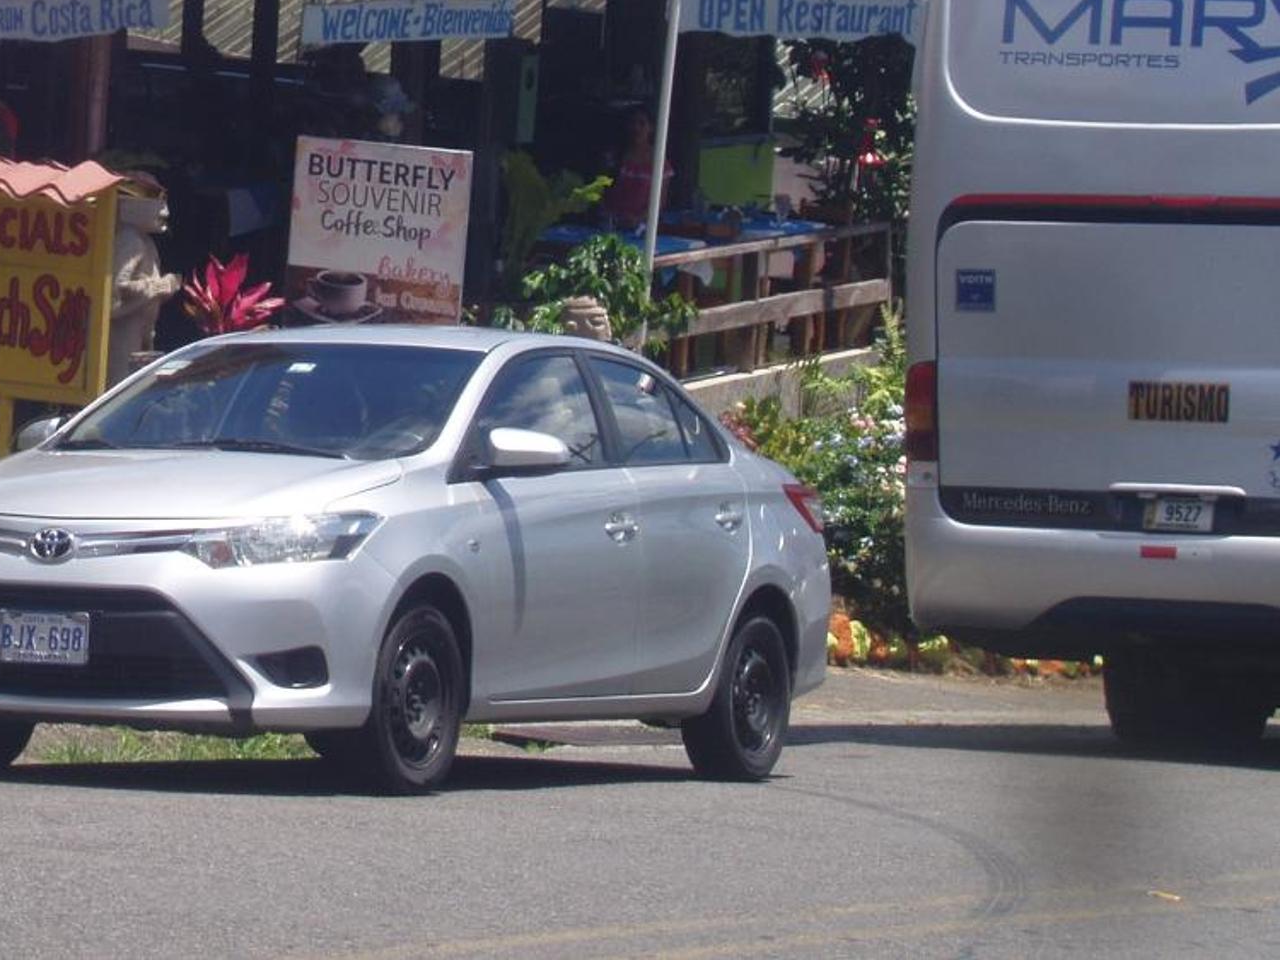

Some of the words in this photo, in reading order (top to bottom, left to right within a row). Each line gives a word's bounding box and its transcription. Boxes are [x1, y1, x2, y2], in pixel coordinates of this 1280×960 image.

[999, 50, 1180, 69] TRANSPORTES
[308, 153, 456, 191] BUTTERFLY
[317, 180, 442, 217] SOUVENIR
[382, 215, 431, 250] Shop
[1129, 381, 1231, 424] TURISMO
[962, 492, 1093, 515] Mercedes-Benz
[1164, 504, 1203, 523] 9527
